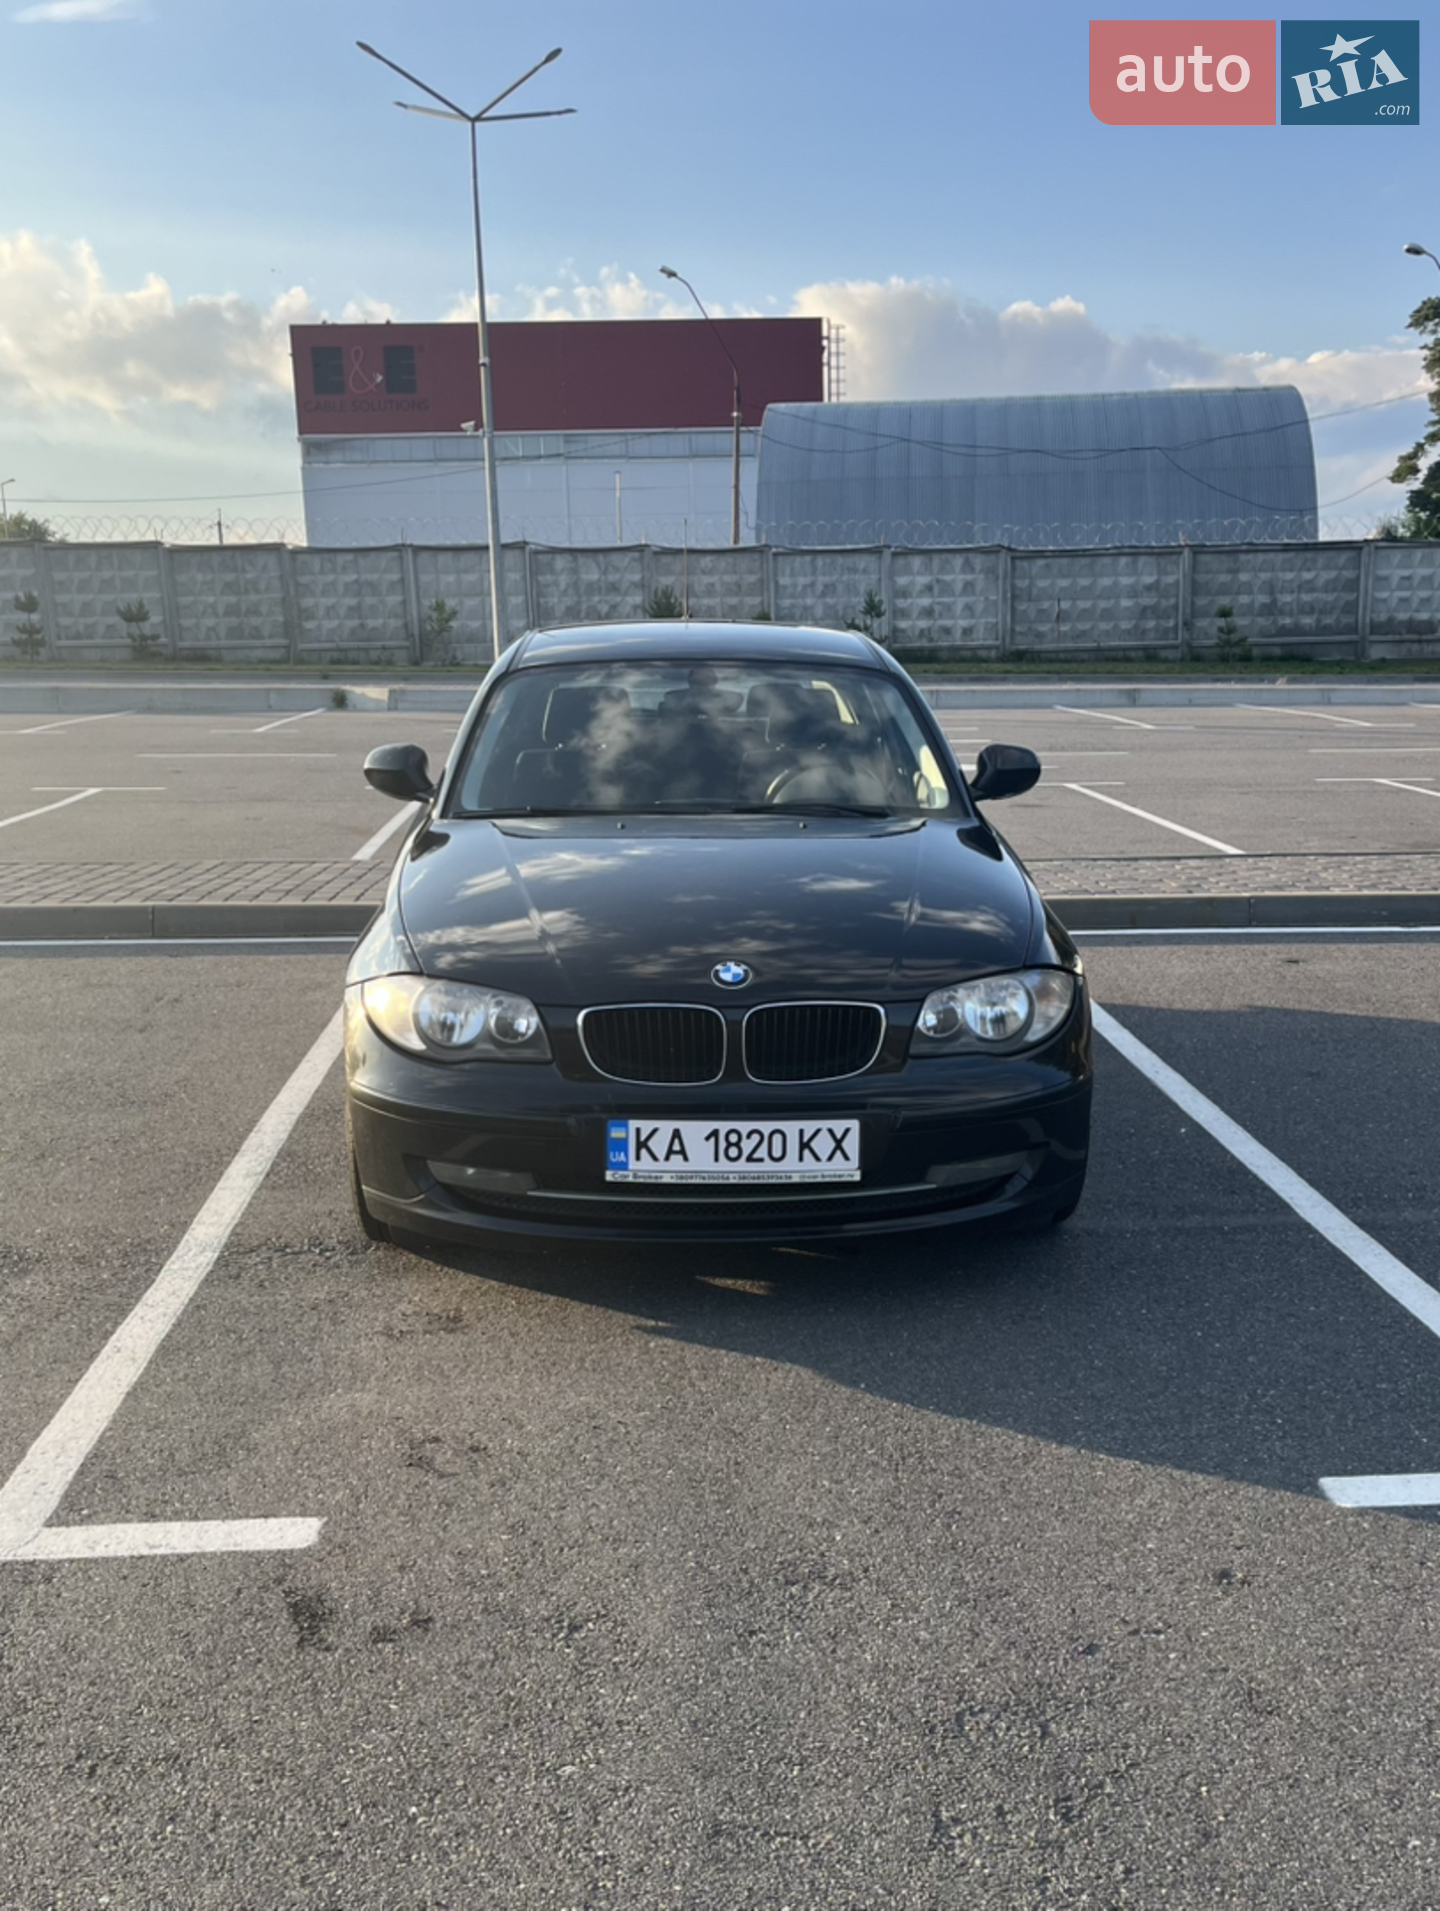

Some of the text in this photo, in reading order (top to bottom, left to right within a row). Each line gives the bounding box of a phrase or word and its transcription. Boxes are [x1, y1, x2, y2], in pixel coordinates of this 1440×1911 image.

[303, 399, 430, 413] CABLE SOLUTIONS
[634, 1127, 852, 1163] KA 1820 KX
[610, 1151, 627, 1163] UA
[611, 1172, 630, 1180] Car
[632, 1172, 664, 1180] Broker
